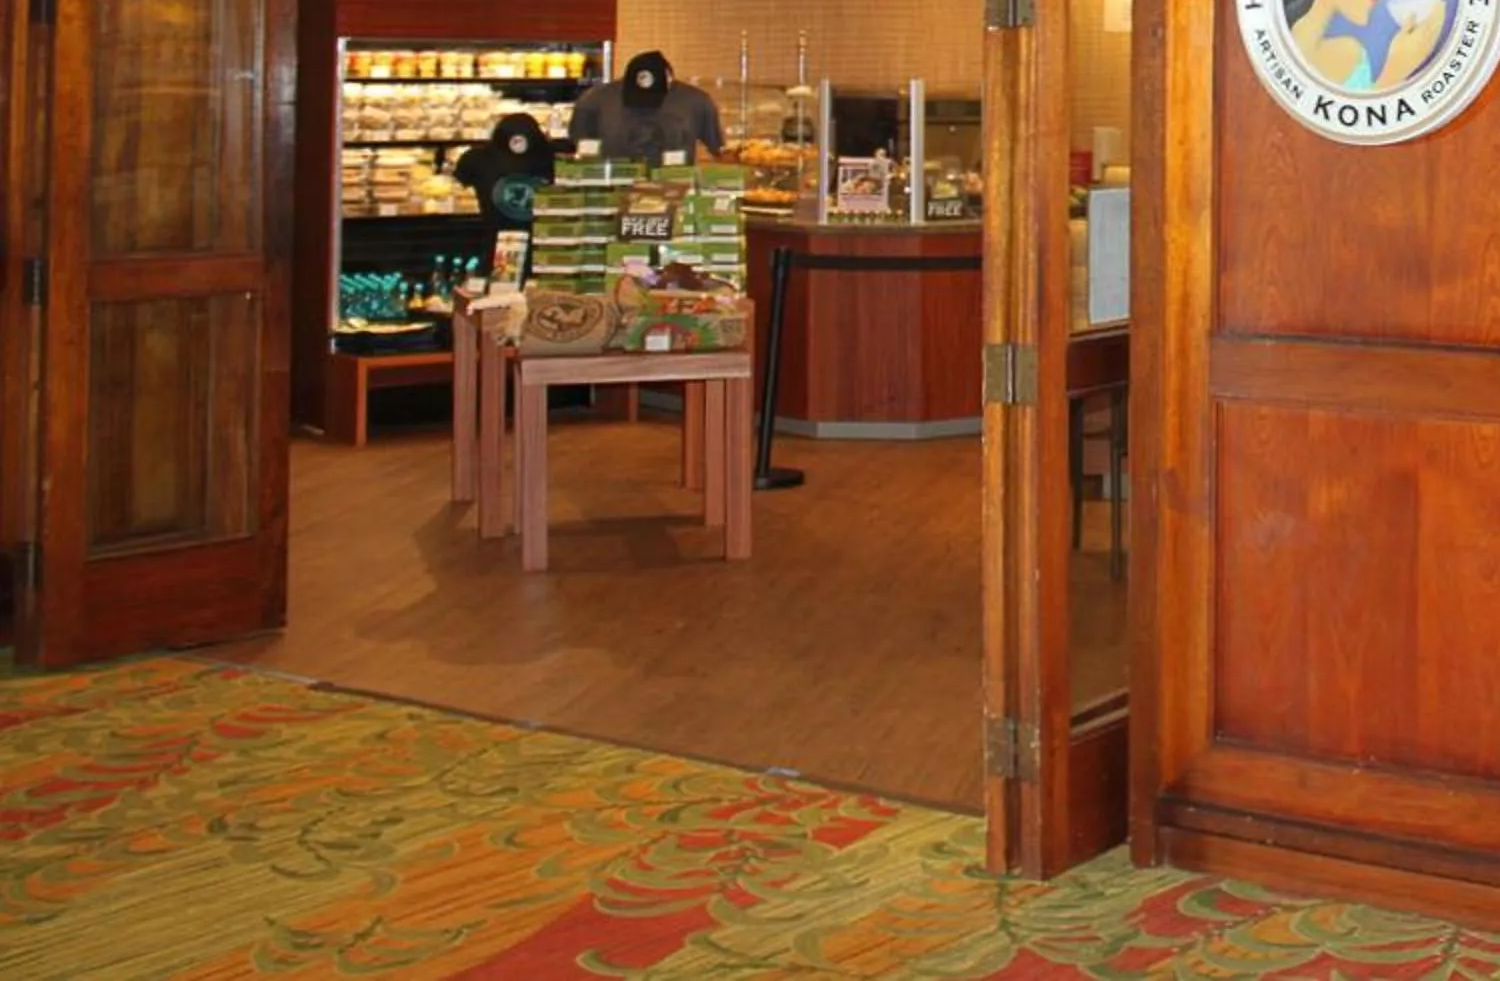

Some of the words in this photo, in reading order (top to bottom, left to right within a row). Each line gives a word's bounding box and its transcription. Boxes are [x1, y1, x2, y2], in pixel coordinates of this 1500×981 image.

[1255, 29, 1304, 99] ARTISAN
[1313, 94, 1416, 128] KONA
[1421, 19, 1479, 104] ROASTER
[621, 223, 668, 236] FREE
